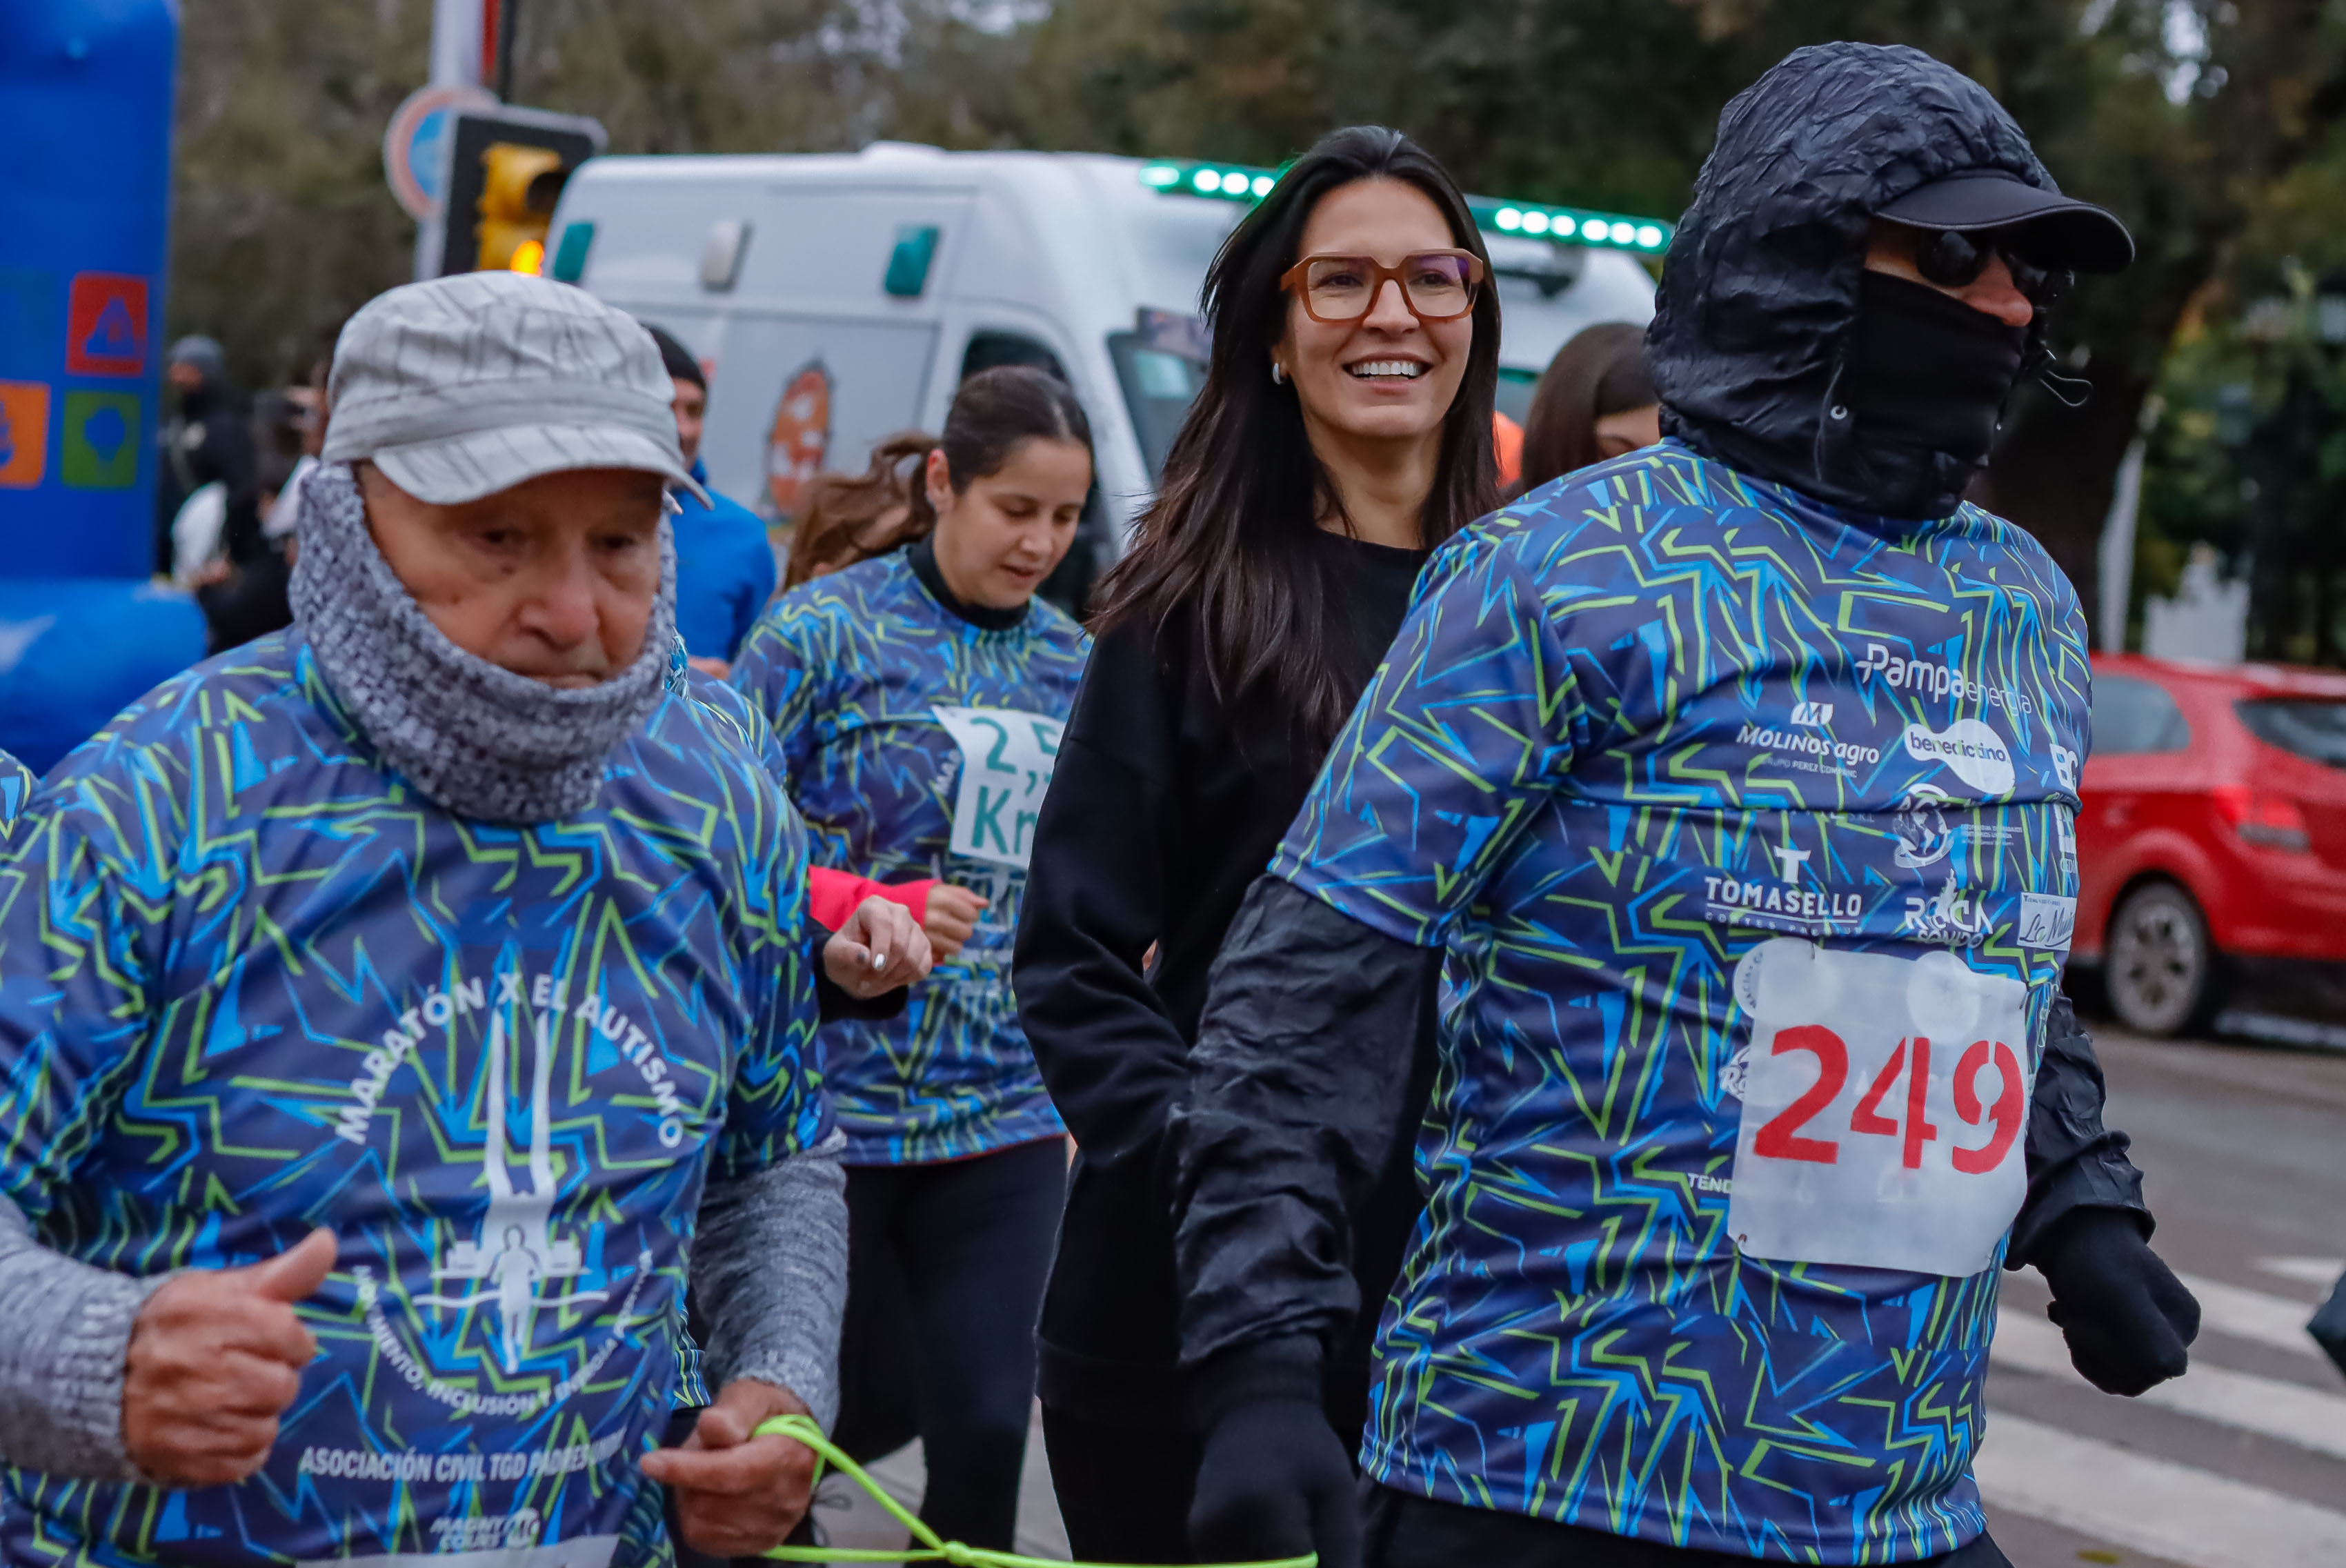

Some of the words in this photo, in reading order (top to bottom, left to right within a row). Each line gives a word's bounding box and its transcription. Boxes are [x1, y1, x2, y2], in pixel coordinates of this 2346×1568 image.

[1736, 724, 1831, 756] MOLINOS
[1833, 742, 1880, 766] agro
[1910, 731, 2007, 762] benedictino
[1704, 875, 1862, 917] TOMASELLO
[335, 975, 486, 1145] MARATÓN
[496, 971, 523, 1004] X
[532, 973, 568, 1011] EL
[574, 993, 684, 1149] AUTISMO
[1753, 1024, 2025, 1175] 249
[300, 1446, 431, 1482] ASOCIACIÓN
[435, 1453, 485, 1482] CIVIL
[489, 1451, 530, 1481] TGD
